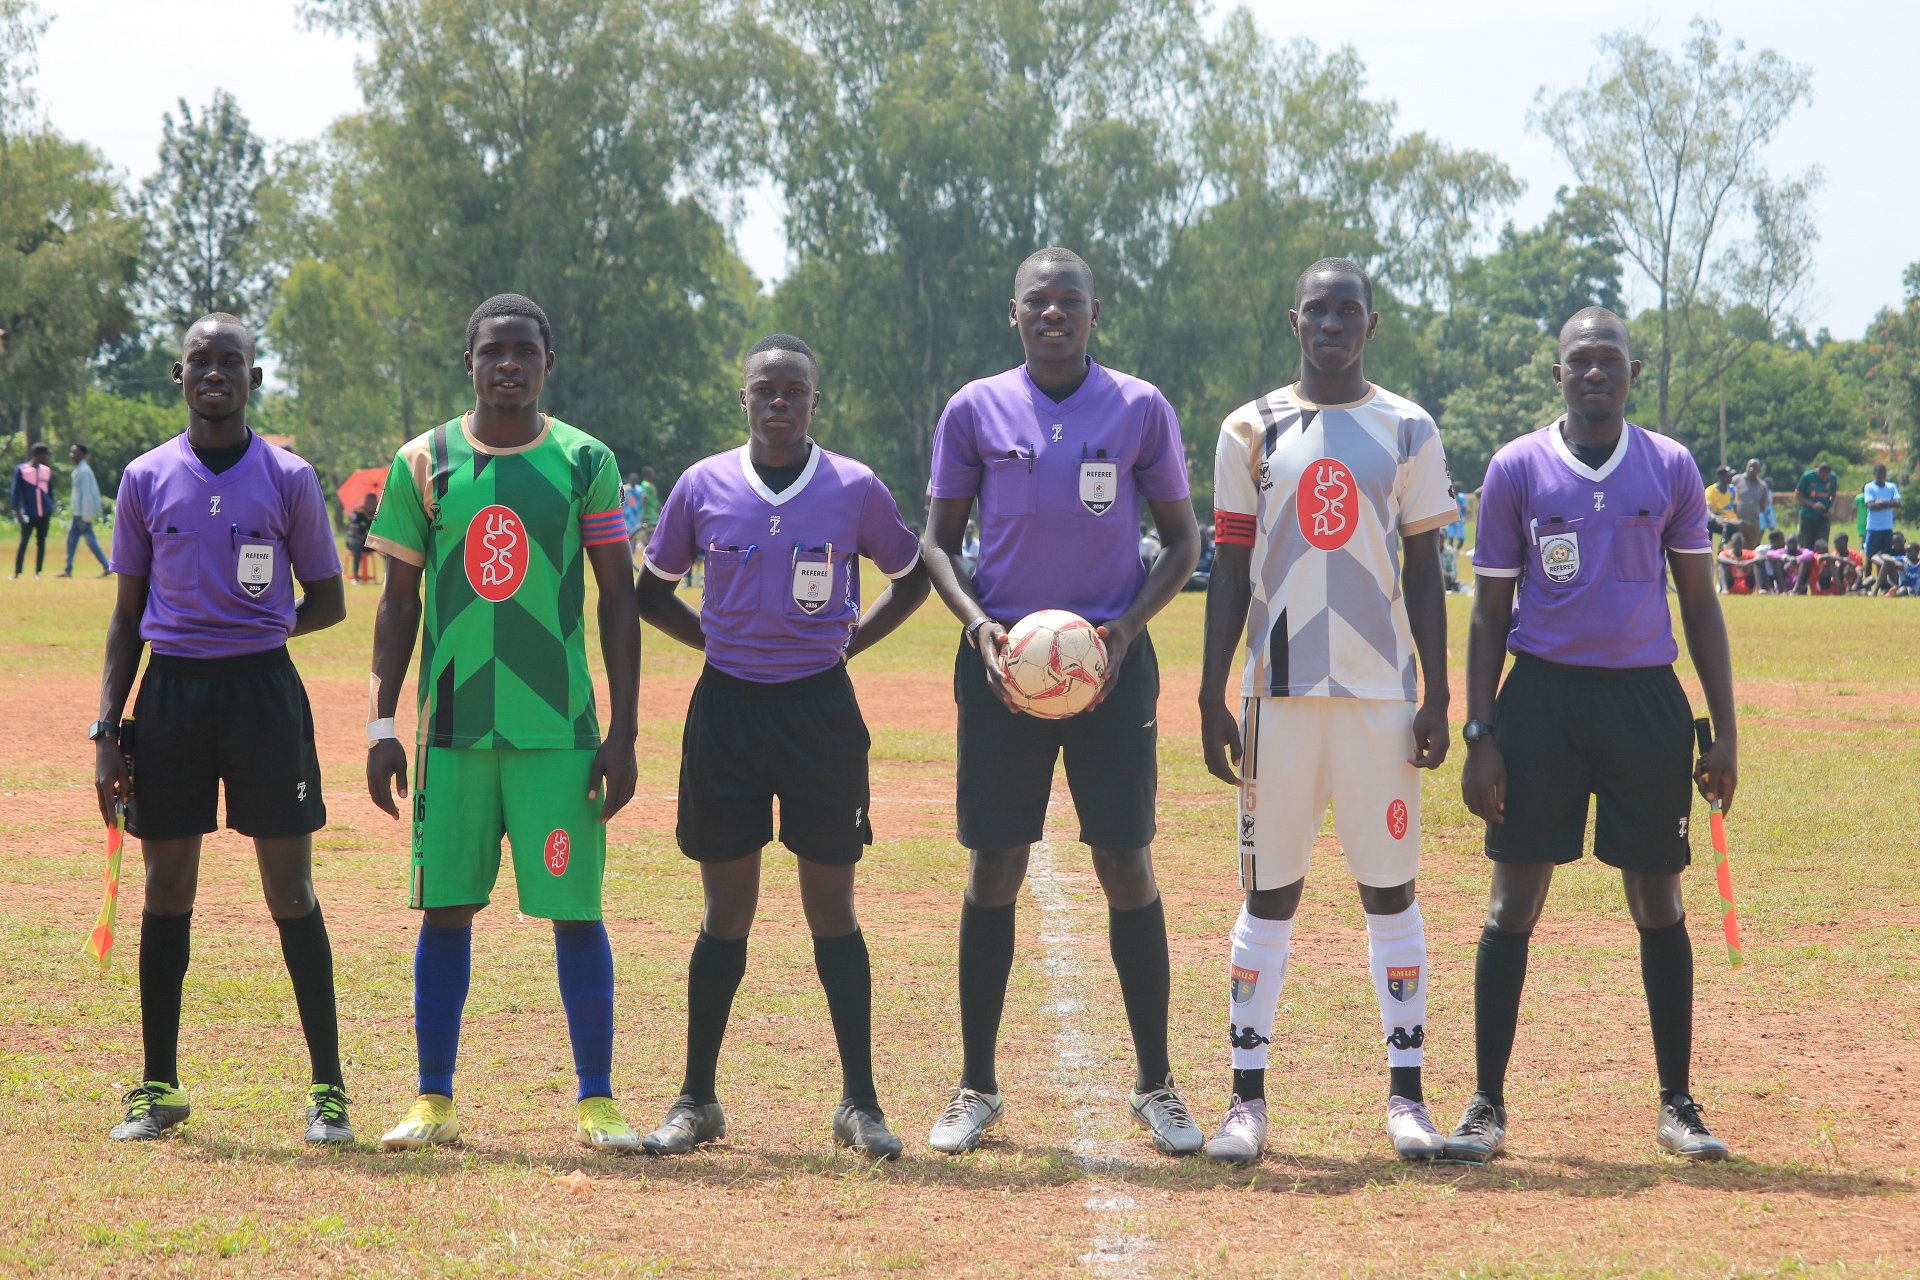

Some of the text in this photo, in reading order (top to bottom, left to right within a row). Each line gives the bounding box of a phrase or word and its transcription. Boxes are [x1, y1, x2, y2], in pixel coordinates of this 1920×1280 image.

[245, 552, 270, 560] REFEREE
[1549, 563, 1575, 572] REFEREE
[801, 569, 828, 577] REFEREE
[1240, 782, 1256, 812] 15
[413, 793, 426, 822] 16
[1390, 969, 1417, 977] AMUS
[1391, 981, 1415, 991] C S
